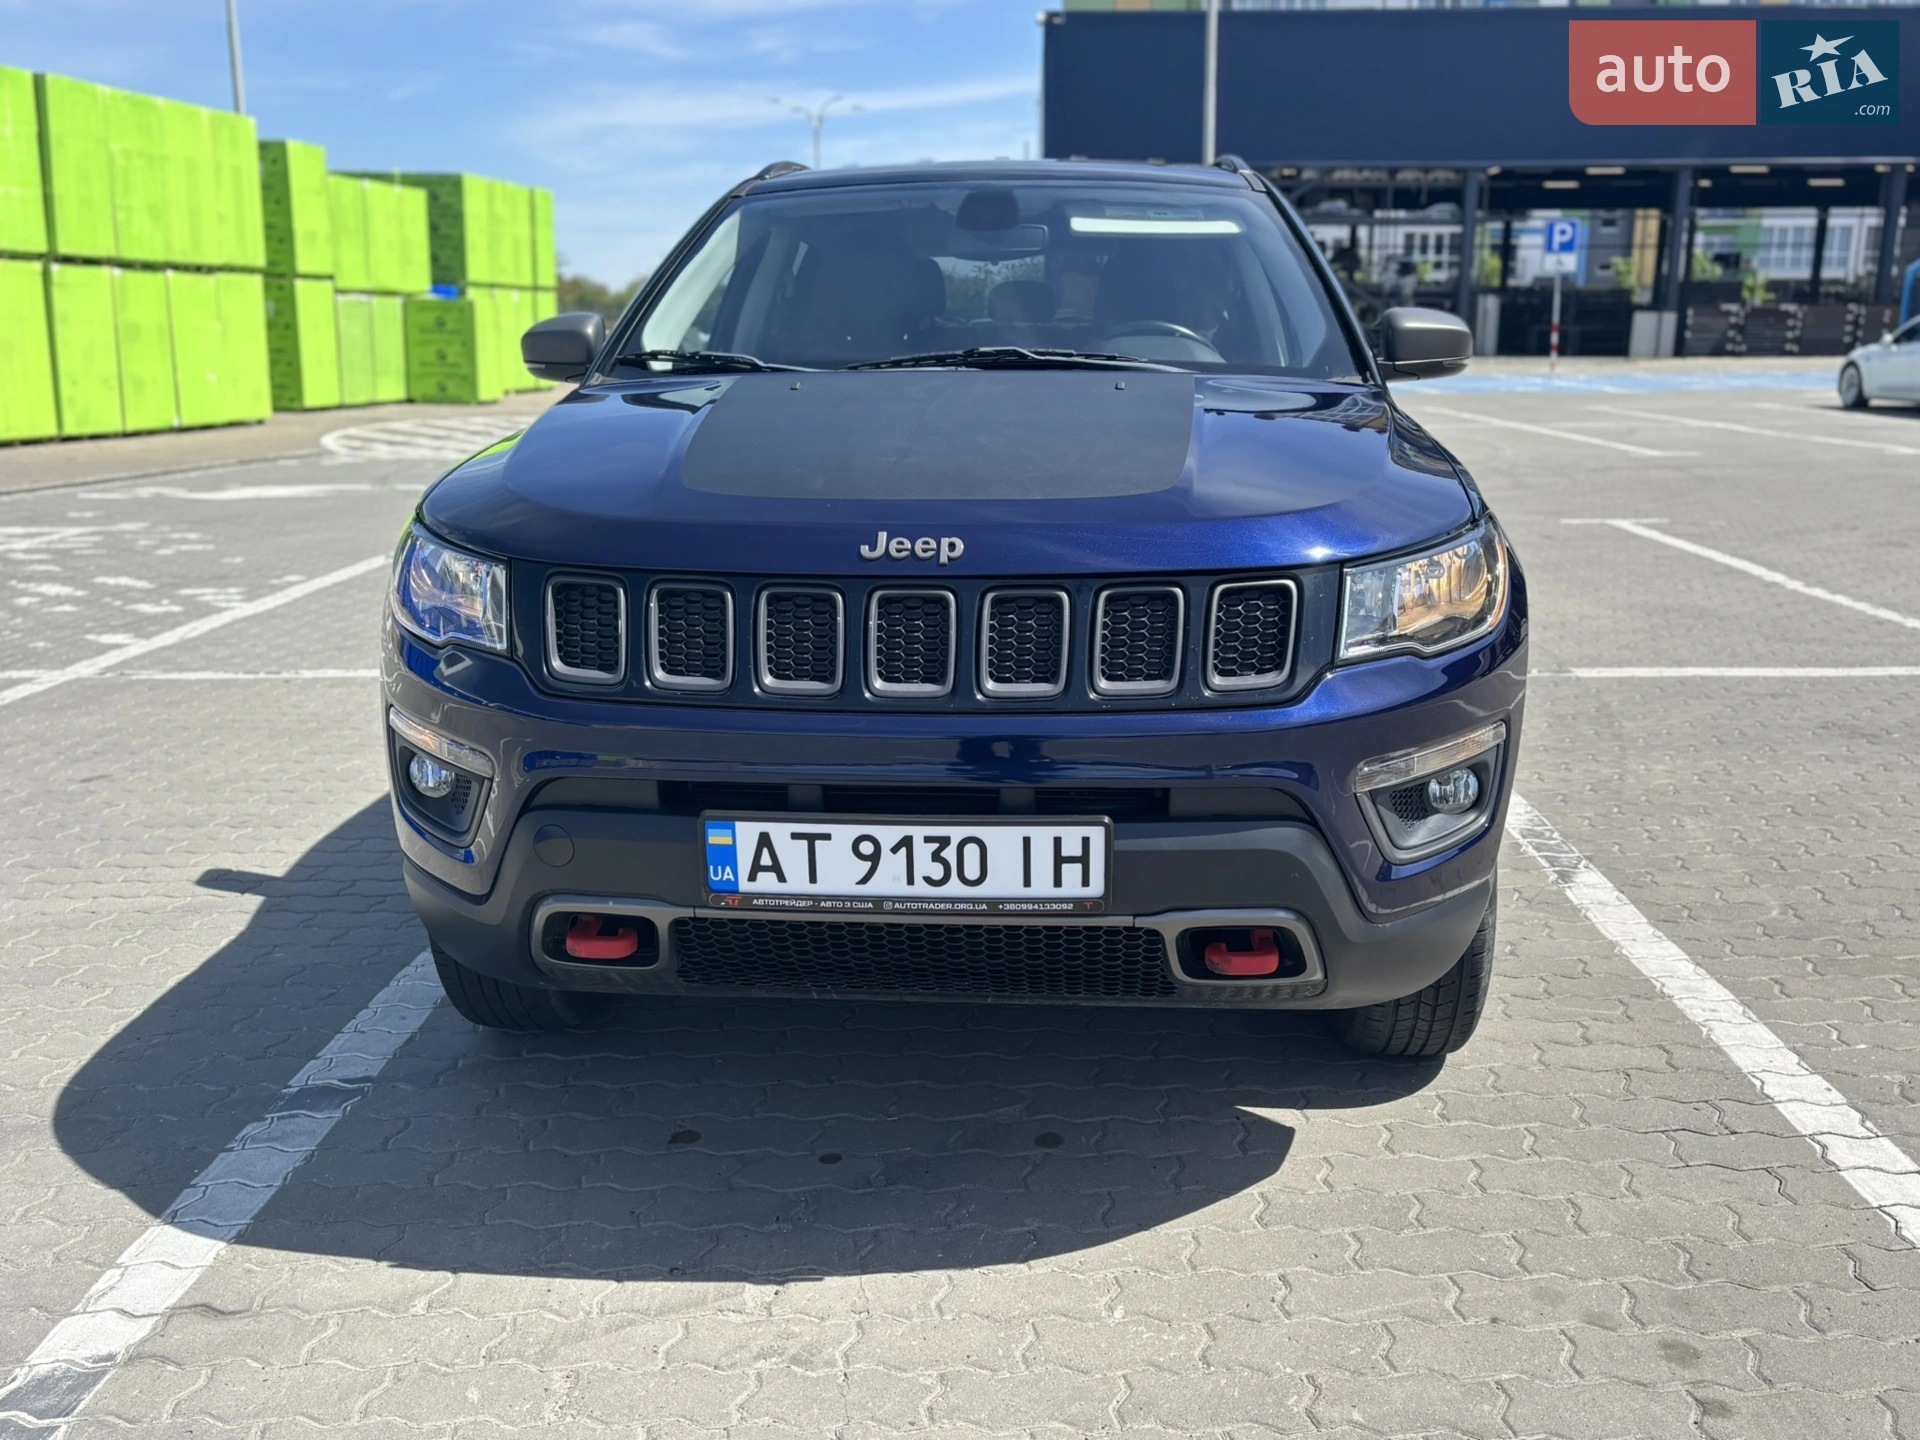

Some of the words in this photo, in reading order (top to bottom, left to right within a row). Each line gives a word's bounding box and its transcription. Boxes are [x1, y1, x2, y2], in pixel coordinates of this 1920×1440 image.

[1552, 222, 1574, 251] P
[860, 531, 965, 566] Jeep
[747, 831, 832, 885] AT
[851, 833, 988, 888] 9130
[1022, 835, 1091, 889] IH
[709, 865, 735, 882] UA
[752, 898, 813, 908] АВТОТРЕЙДЕР
[820, 901, 843, 909] АВТО
[852, 901, 874, 909] США
[893, 901, 988, 911] AUTOTRADER.ORG.UA
